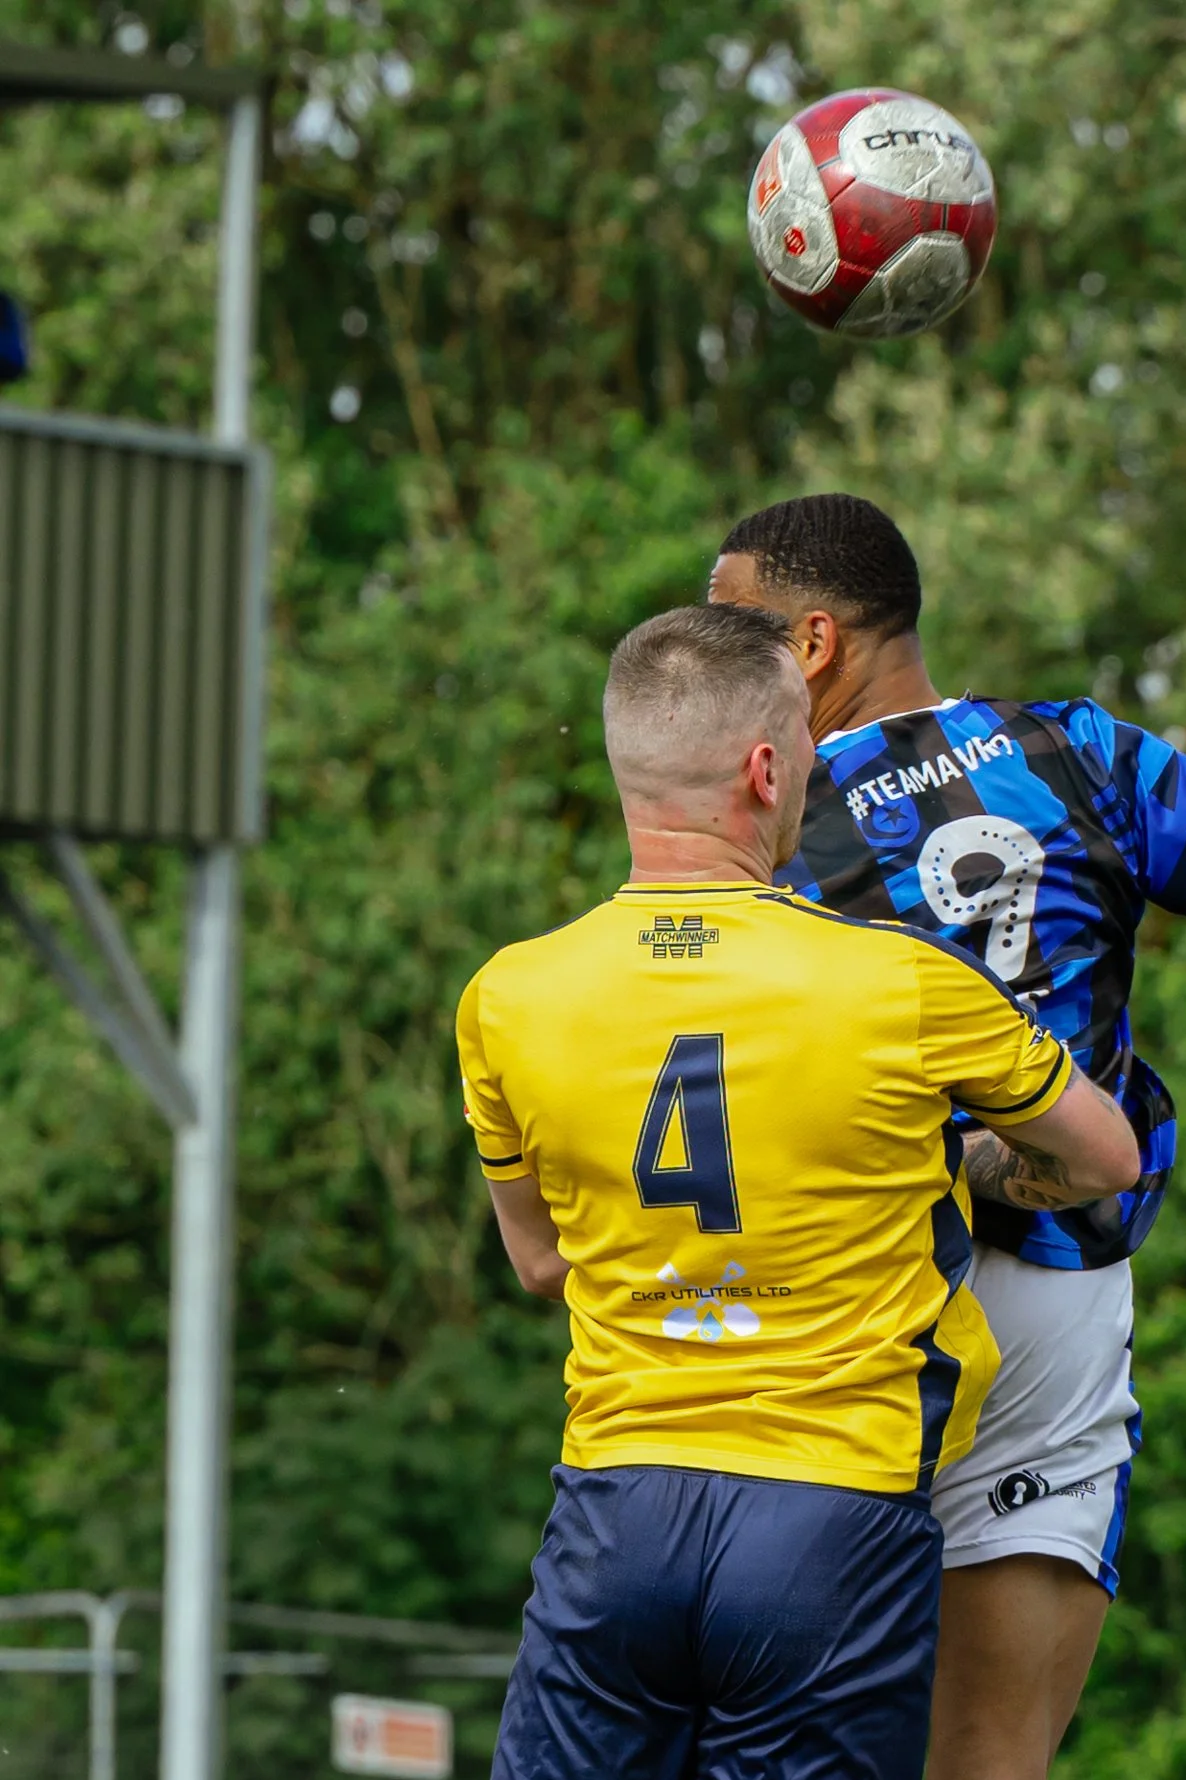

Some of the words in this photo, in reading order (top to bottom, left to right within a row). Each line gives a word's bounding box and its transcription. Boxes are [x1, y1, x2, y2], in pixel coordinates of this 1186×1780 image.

[641, 930, 717, 943] MATCHWINNER
[916, 815, 1045, 983] 9
[632, 1032, 743, 1234] 4
[631, 1291, 666, 1302] CKR
[671, 1287, 752, 1300] UTILITIES
[757, 1286, 792, 1297] LTD
